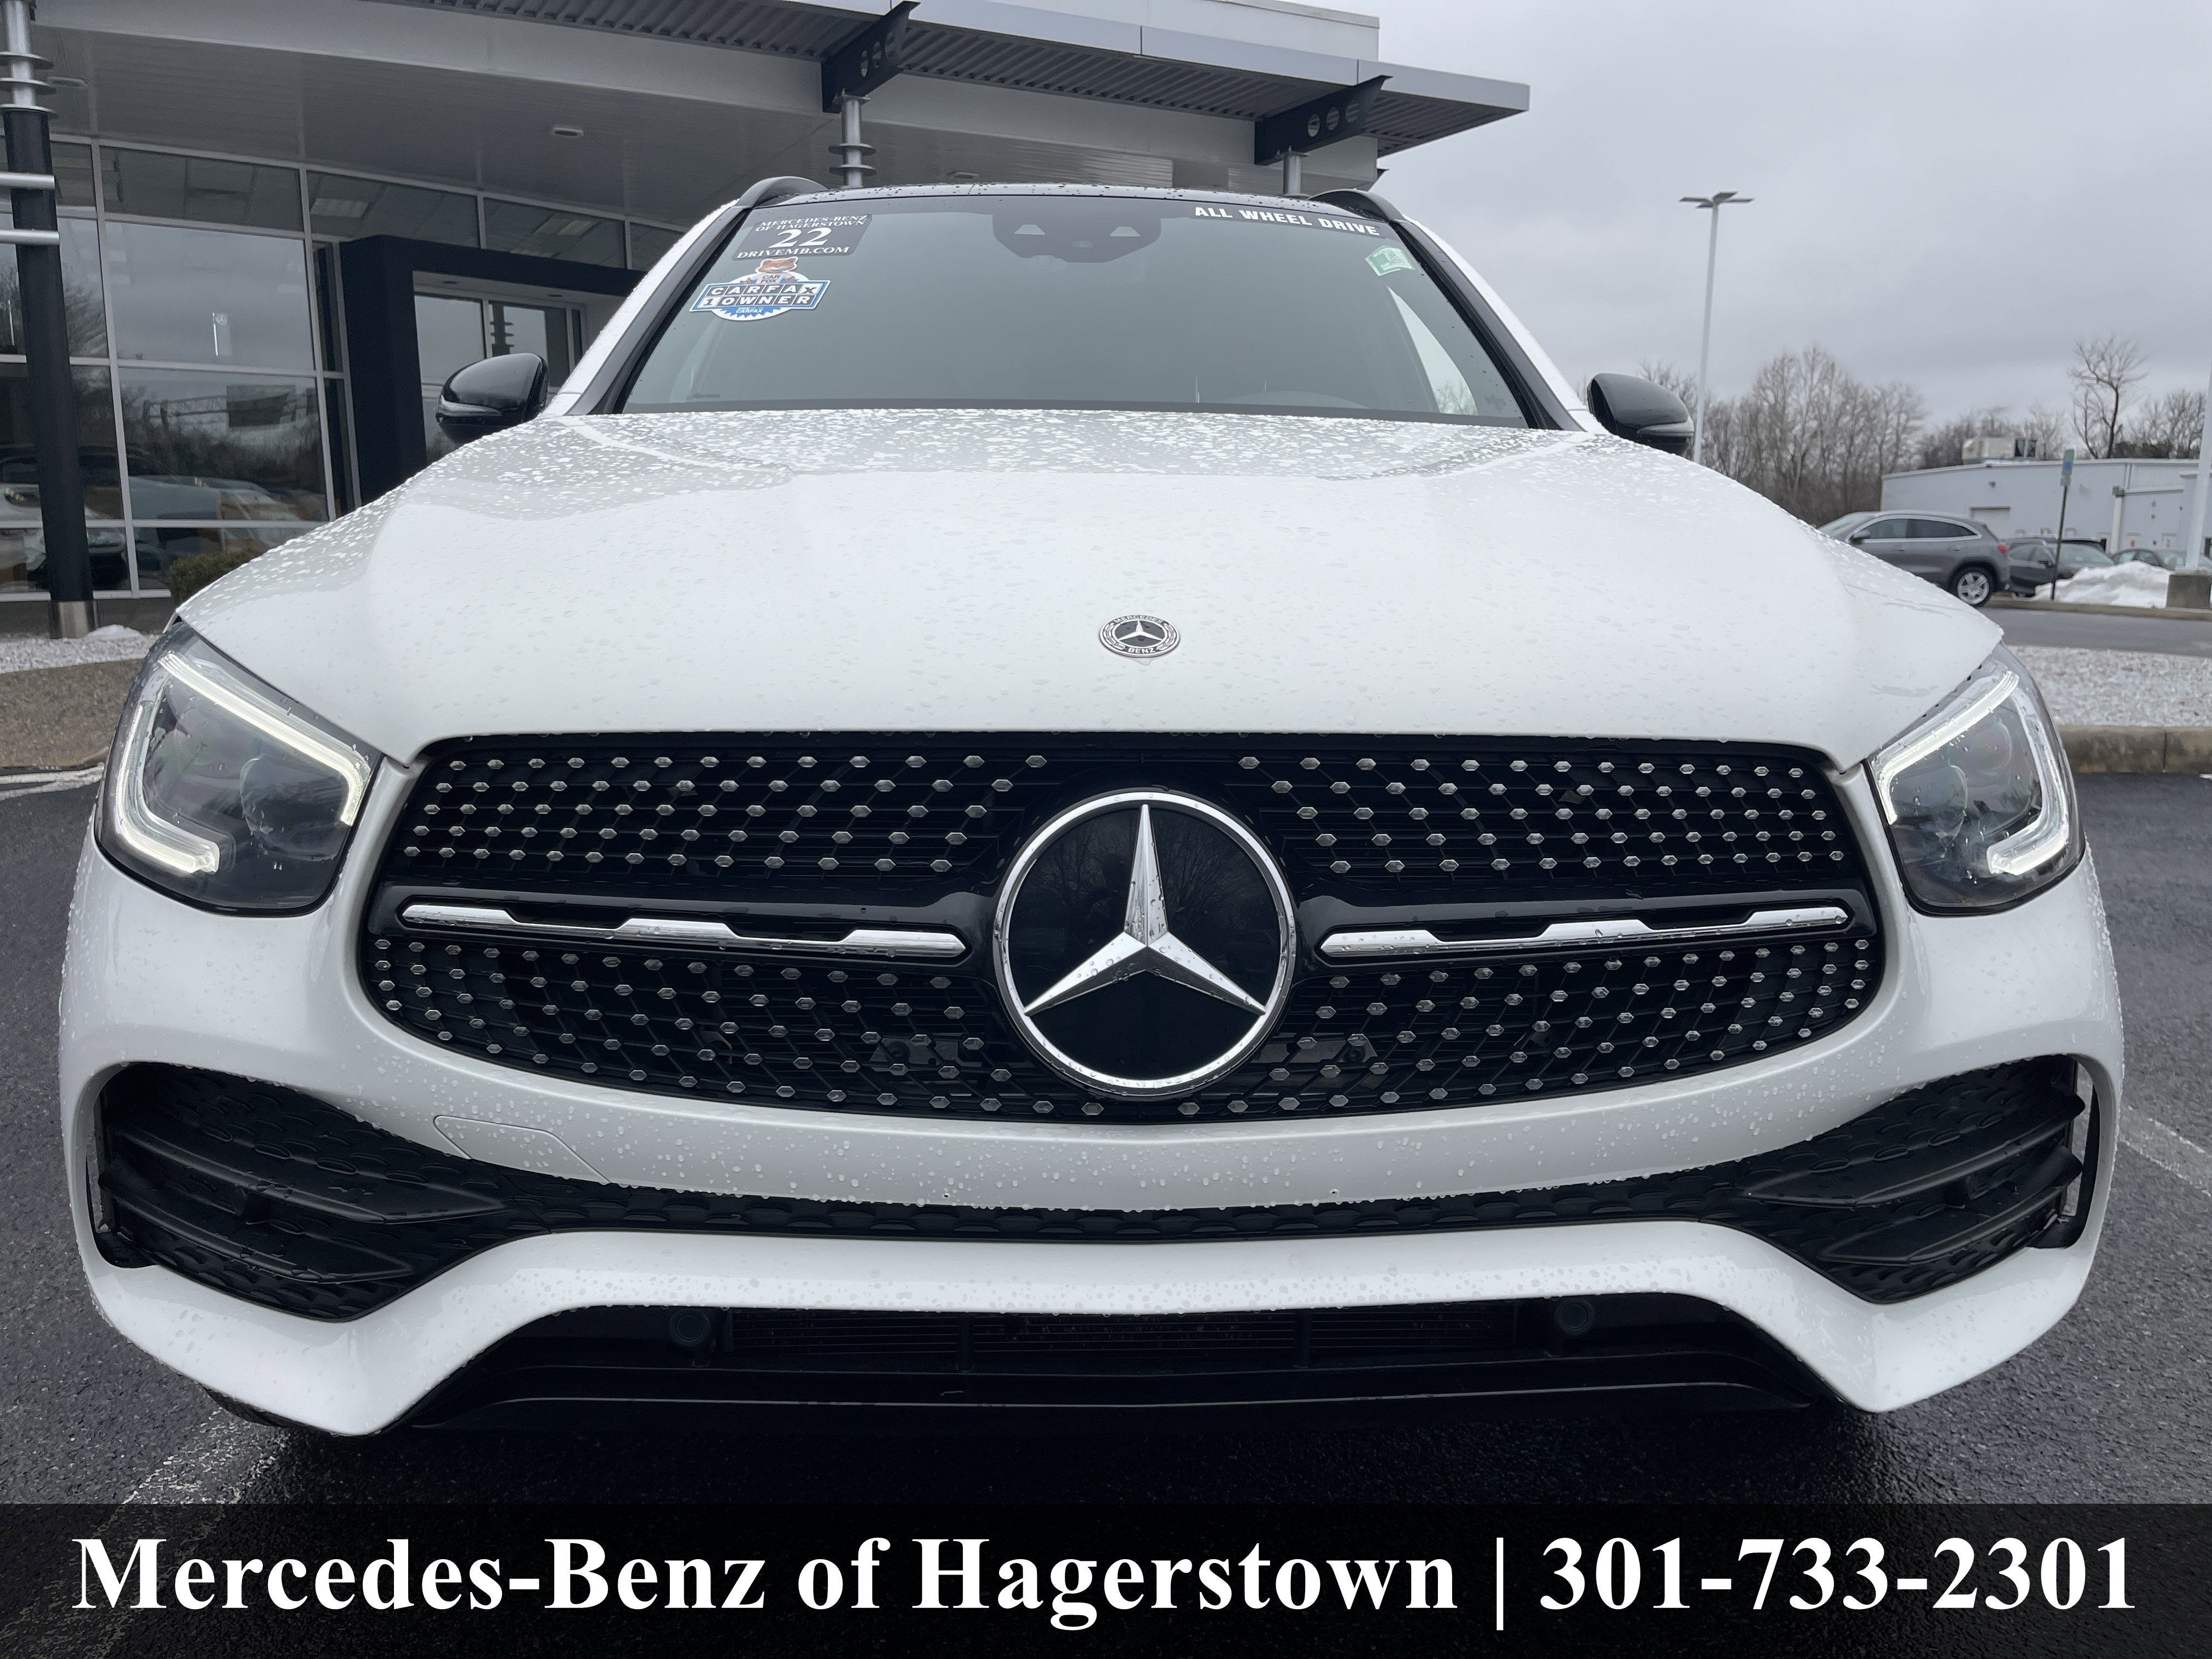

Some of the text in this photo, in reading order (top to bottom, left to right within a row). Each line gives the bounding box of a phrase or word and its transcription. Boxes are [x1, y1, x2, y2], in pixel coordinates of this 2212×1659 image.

[760, 215, 868, 227] MERCEDES-BENZ
[776, 220, 866, 230] HAGERSTOWN
[1194, 207, 1380, 236] ALL WHEEL DRIVE
[769, 227, 832, 249] 22
[737, 246, 850, 259] DRIVEMB.COM
[710, 285, 819, 295] CARFAX
[702, 295, 811, 306] 1 OWNER
[1113, 615, 1164, 624] MERCEDES
